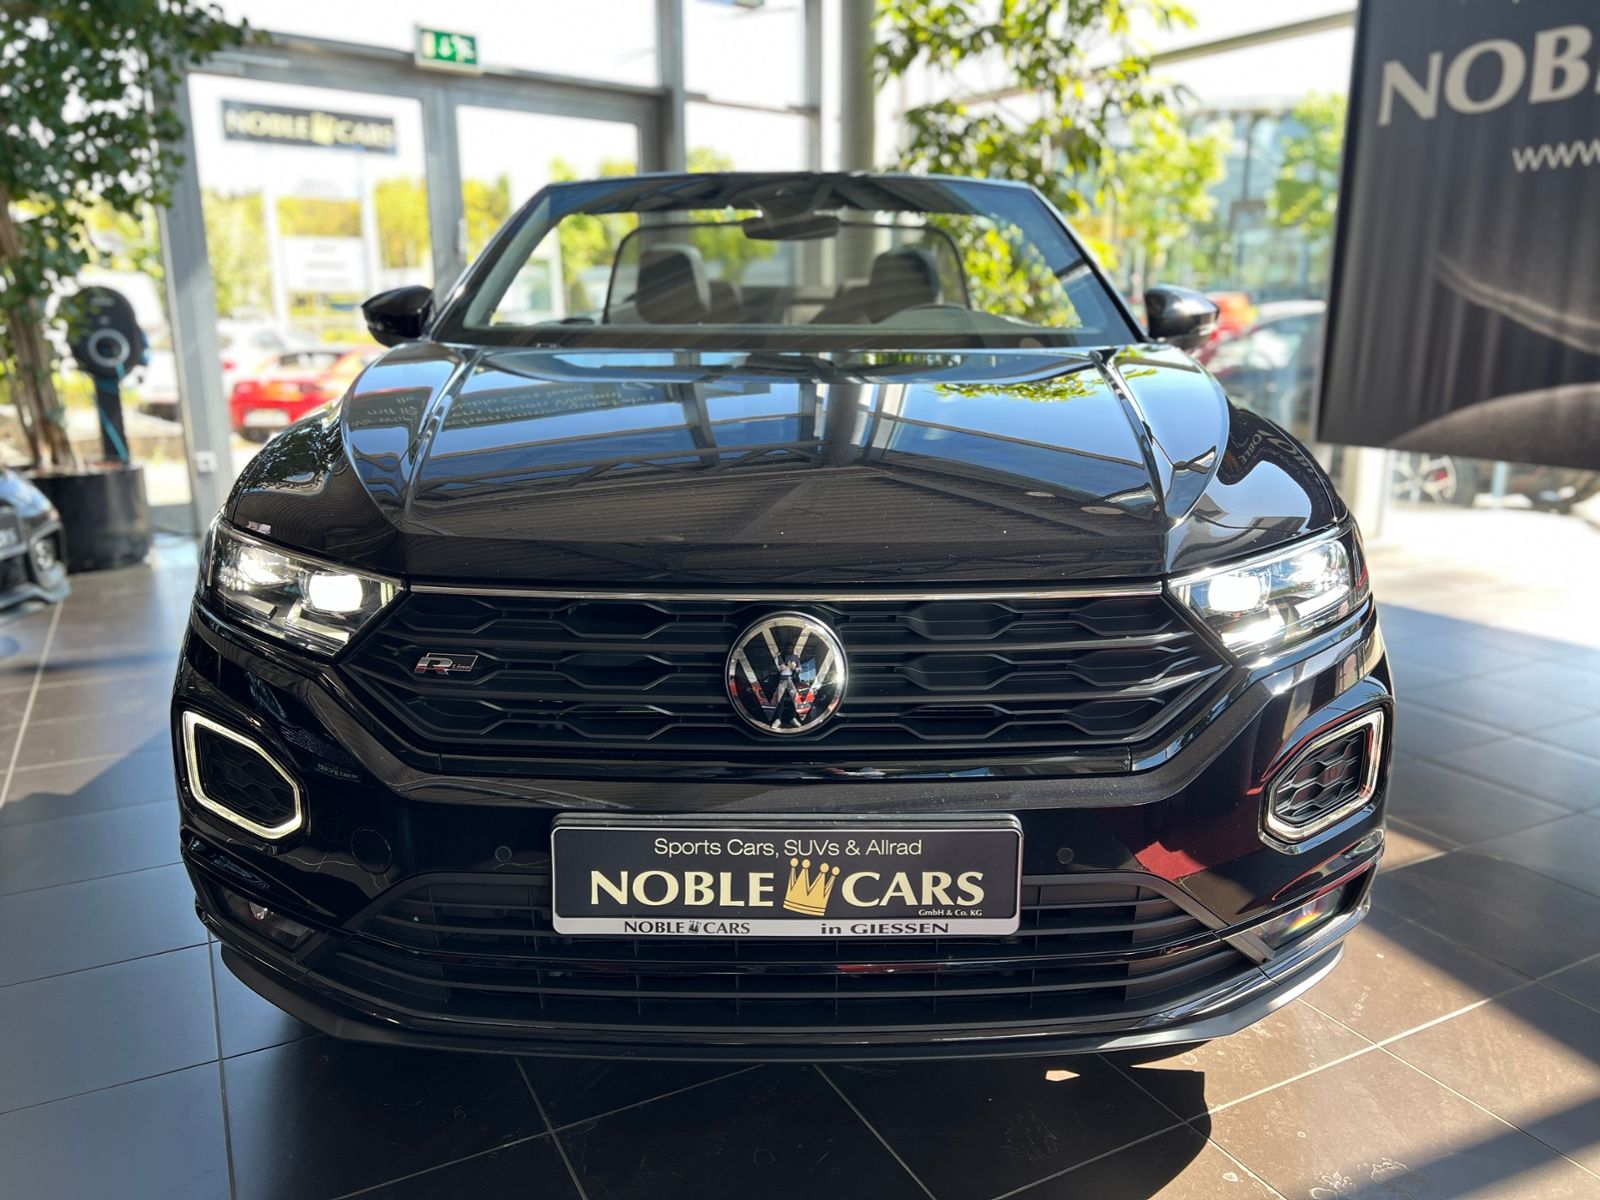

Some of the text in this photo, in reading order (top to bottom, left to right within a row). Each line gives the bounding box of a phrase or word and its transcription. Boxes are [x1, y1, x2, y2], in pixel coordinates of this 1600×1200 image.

[1378, 25, 1600, 127] NOB
[225, 109, 394, 148] NOBLE CARS
[654, 837, 922, 858] Sports Cars, SUVs & Allrad
[590, 870, 985, 908] NOBLE CARS
[624, 920, 949, 935] NOBLE CARS in GIESSEN
